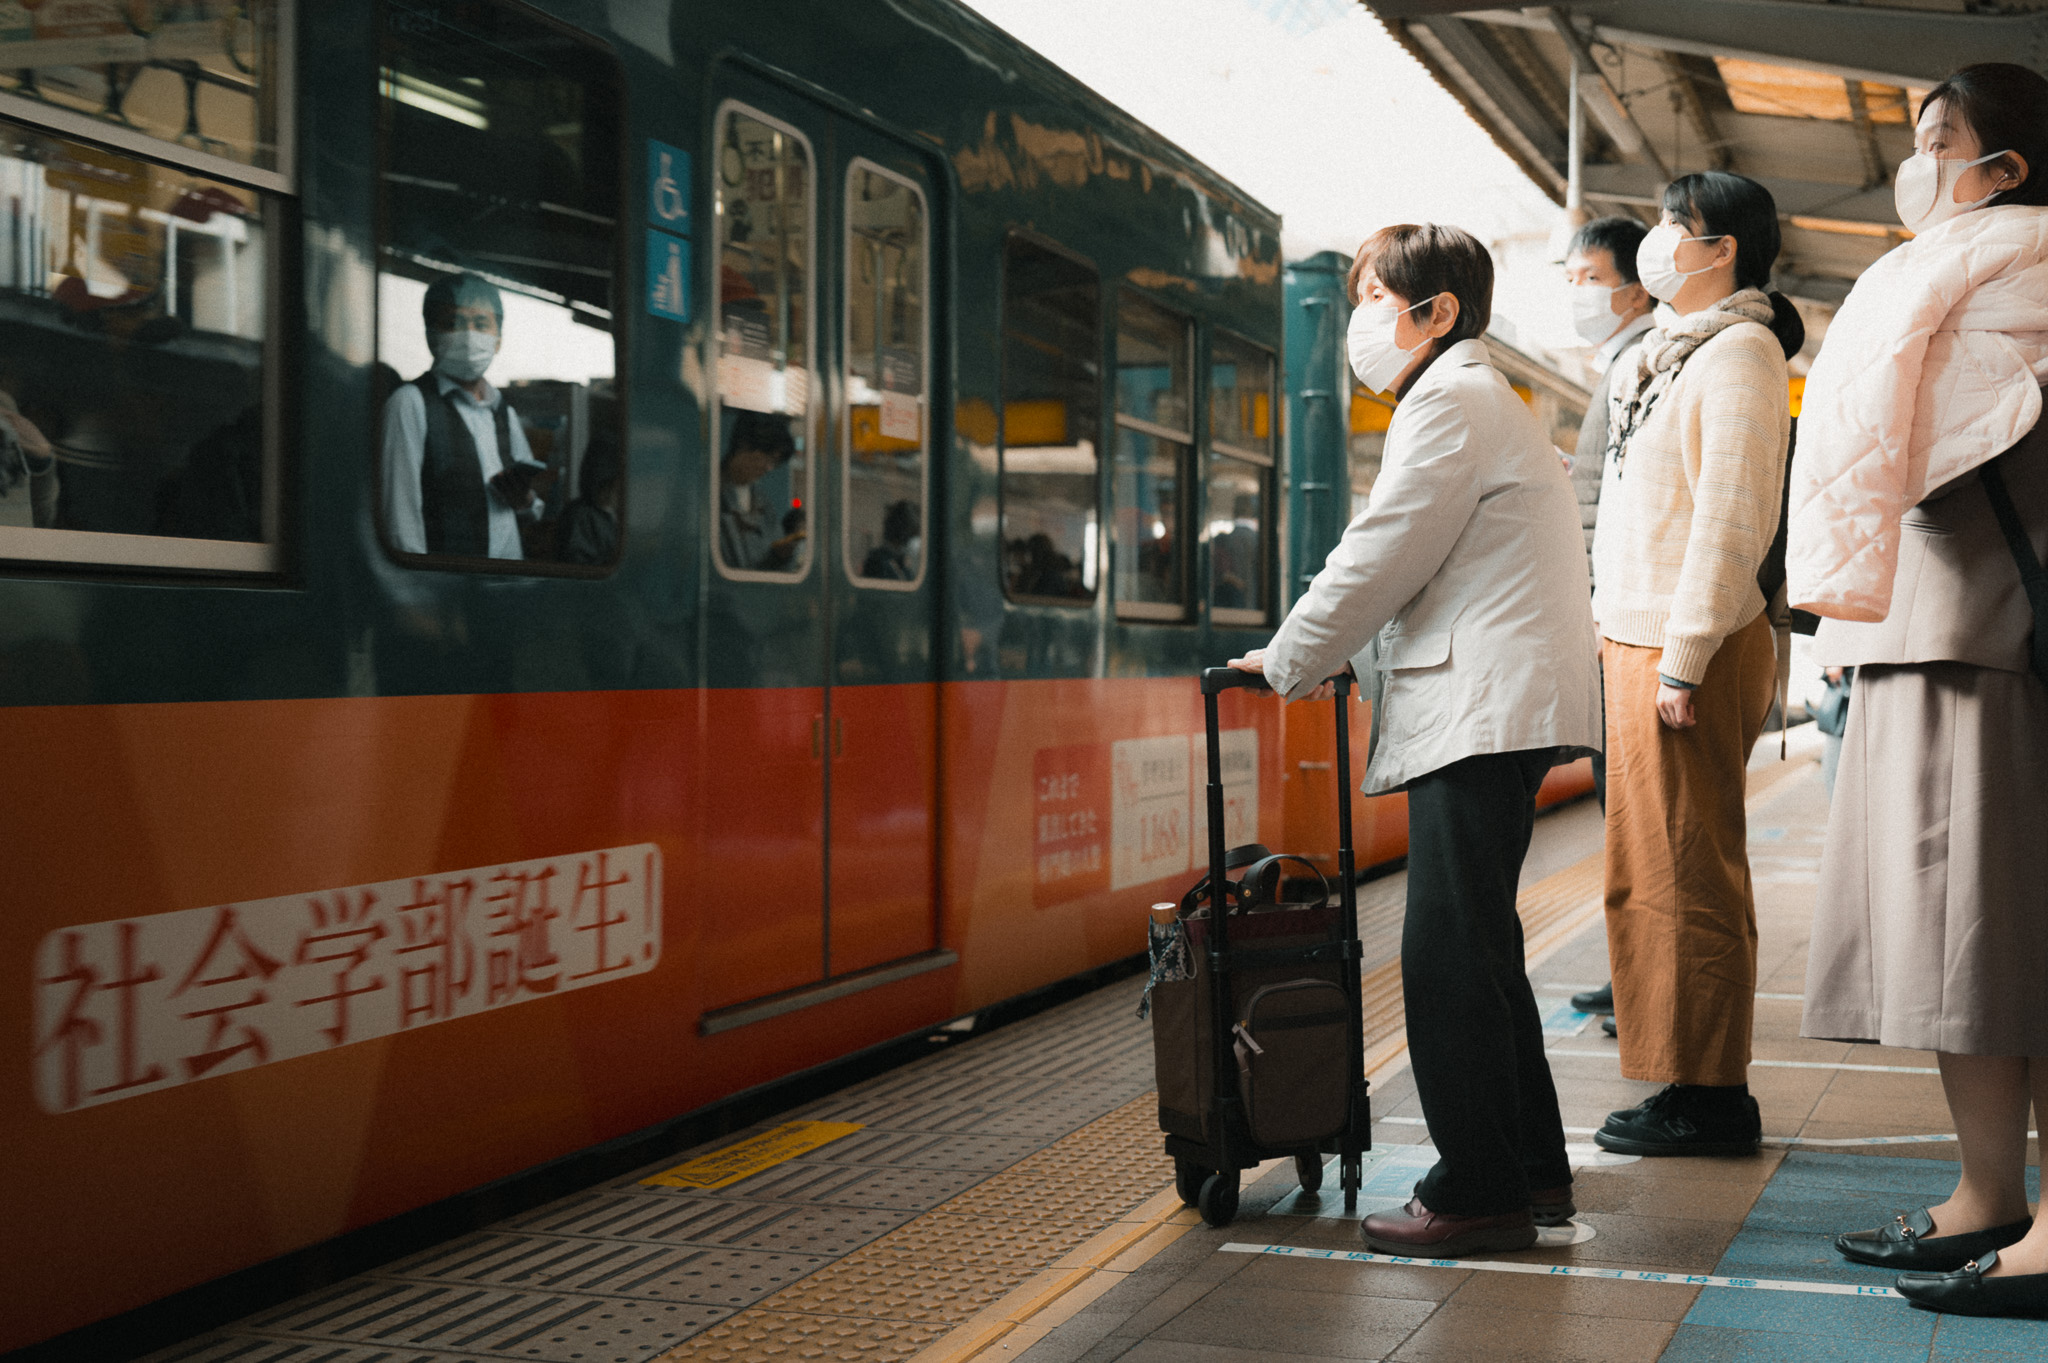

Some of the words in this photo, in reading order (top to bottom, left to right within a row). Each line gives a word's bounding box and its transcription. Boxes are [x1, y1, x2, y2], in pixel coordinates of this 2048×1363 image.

[36, 852, 655, 1107] 社会学部誕生!
